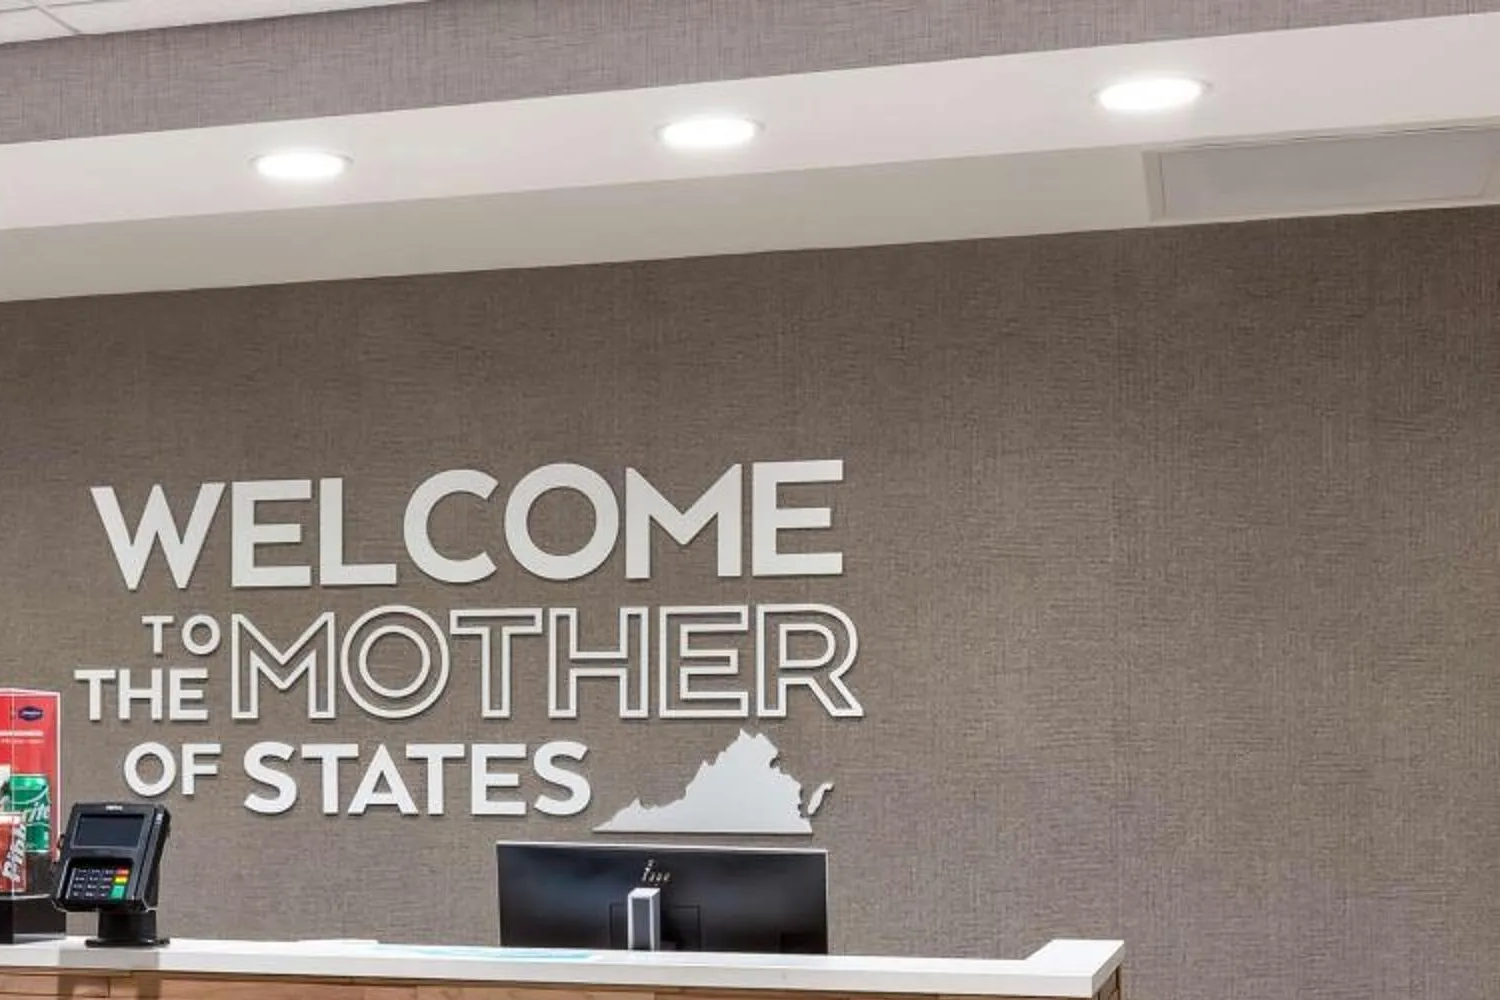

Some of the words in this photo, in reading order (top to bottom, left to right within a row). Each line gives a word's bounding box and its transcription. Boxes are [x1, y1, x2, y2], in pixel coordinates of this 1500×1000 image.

[91, 460, 842, 588] WELCOME
[75, 669, 208, 719] THE
[232, 604, 862, 718] MOTHER
[142, 615, 219, 654] TO
[124, 742, 220, 795] OF
[244, 741, 590, 814] STATES
